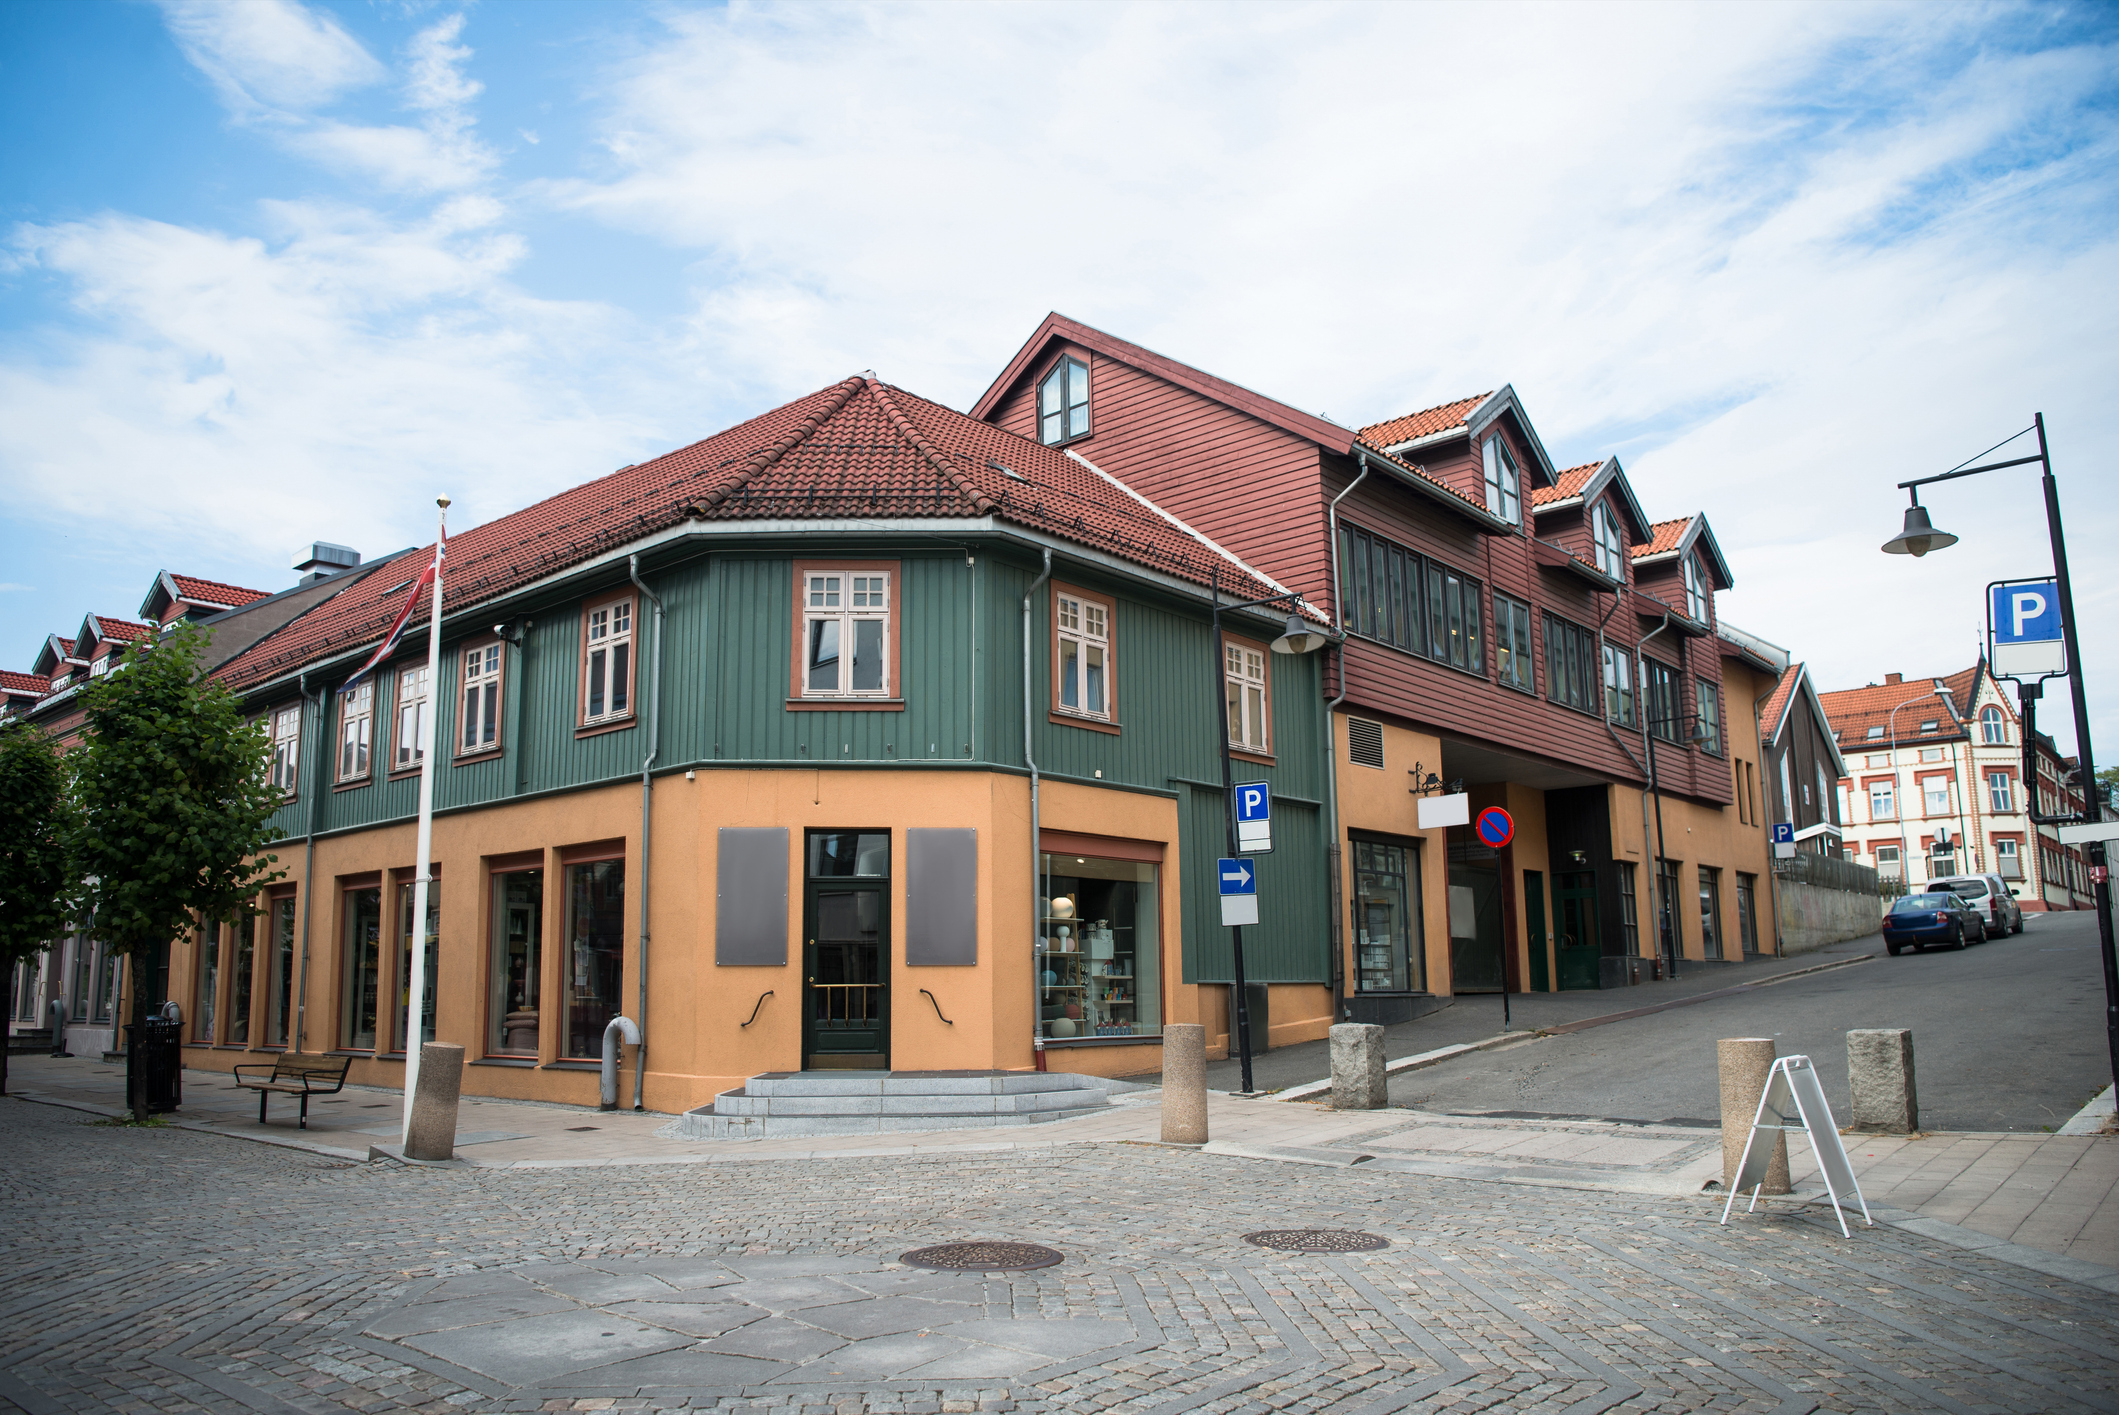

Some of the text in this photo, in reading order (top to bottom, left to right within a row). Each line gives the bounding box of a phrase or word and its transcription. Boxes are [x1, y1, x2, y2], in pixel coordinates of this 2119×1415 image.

[2012, 592, 2046, 636] P
[1245, 790, 1261, 817] P
[1778, 826, 1788, 841] P
